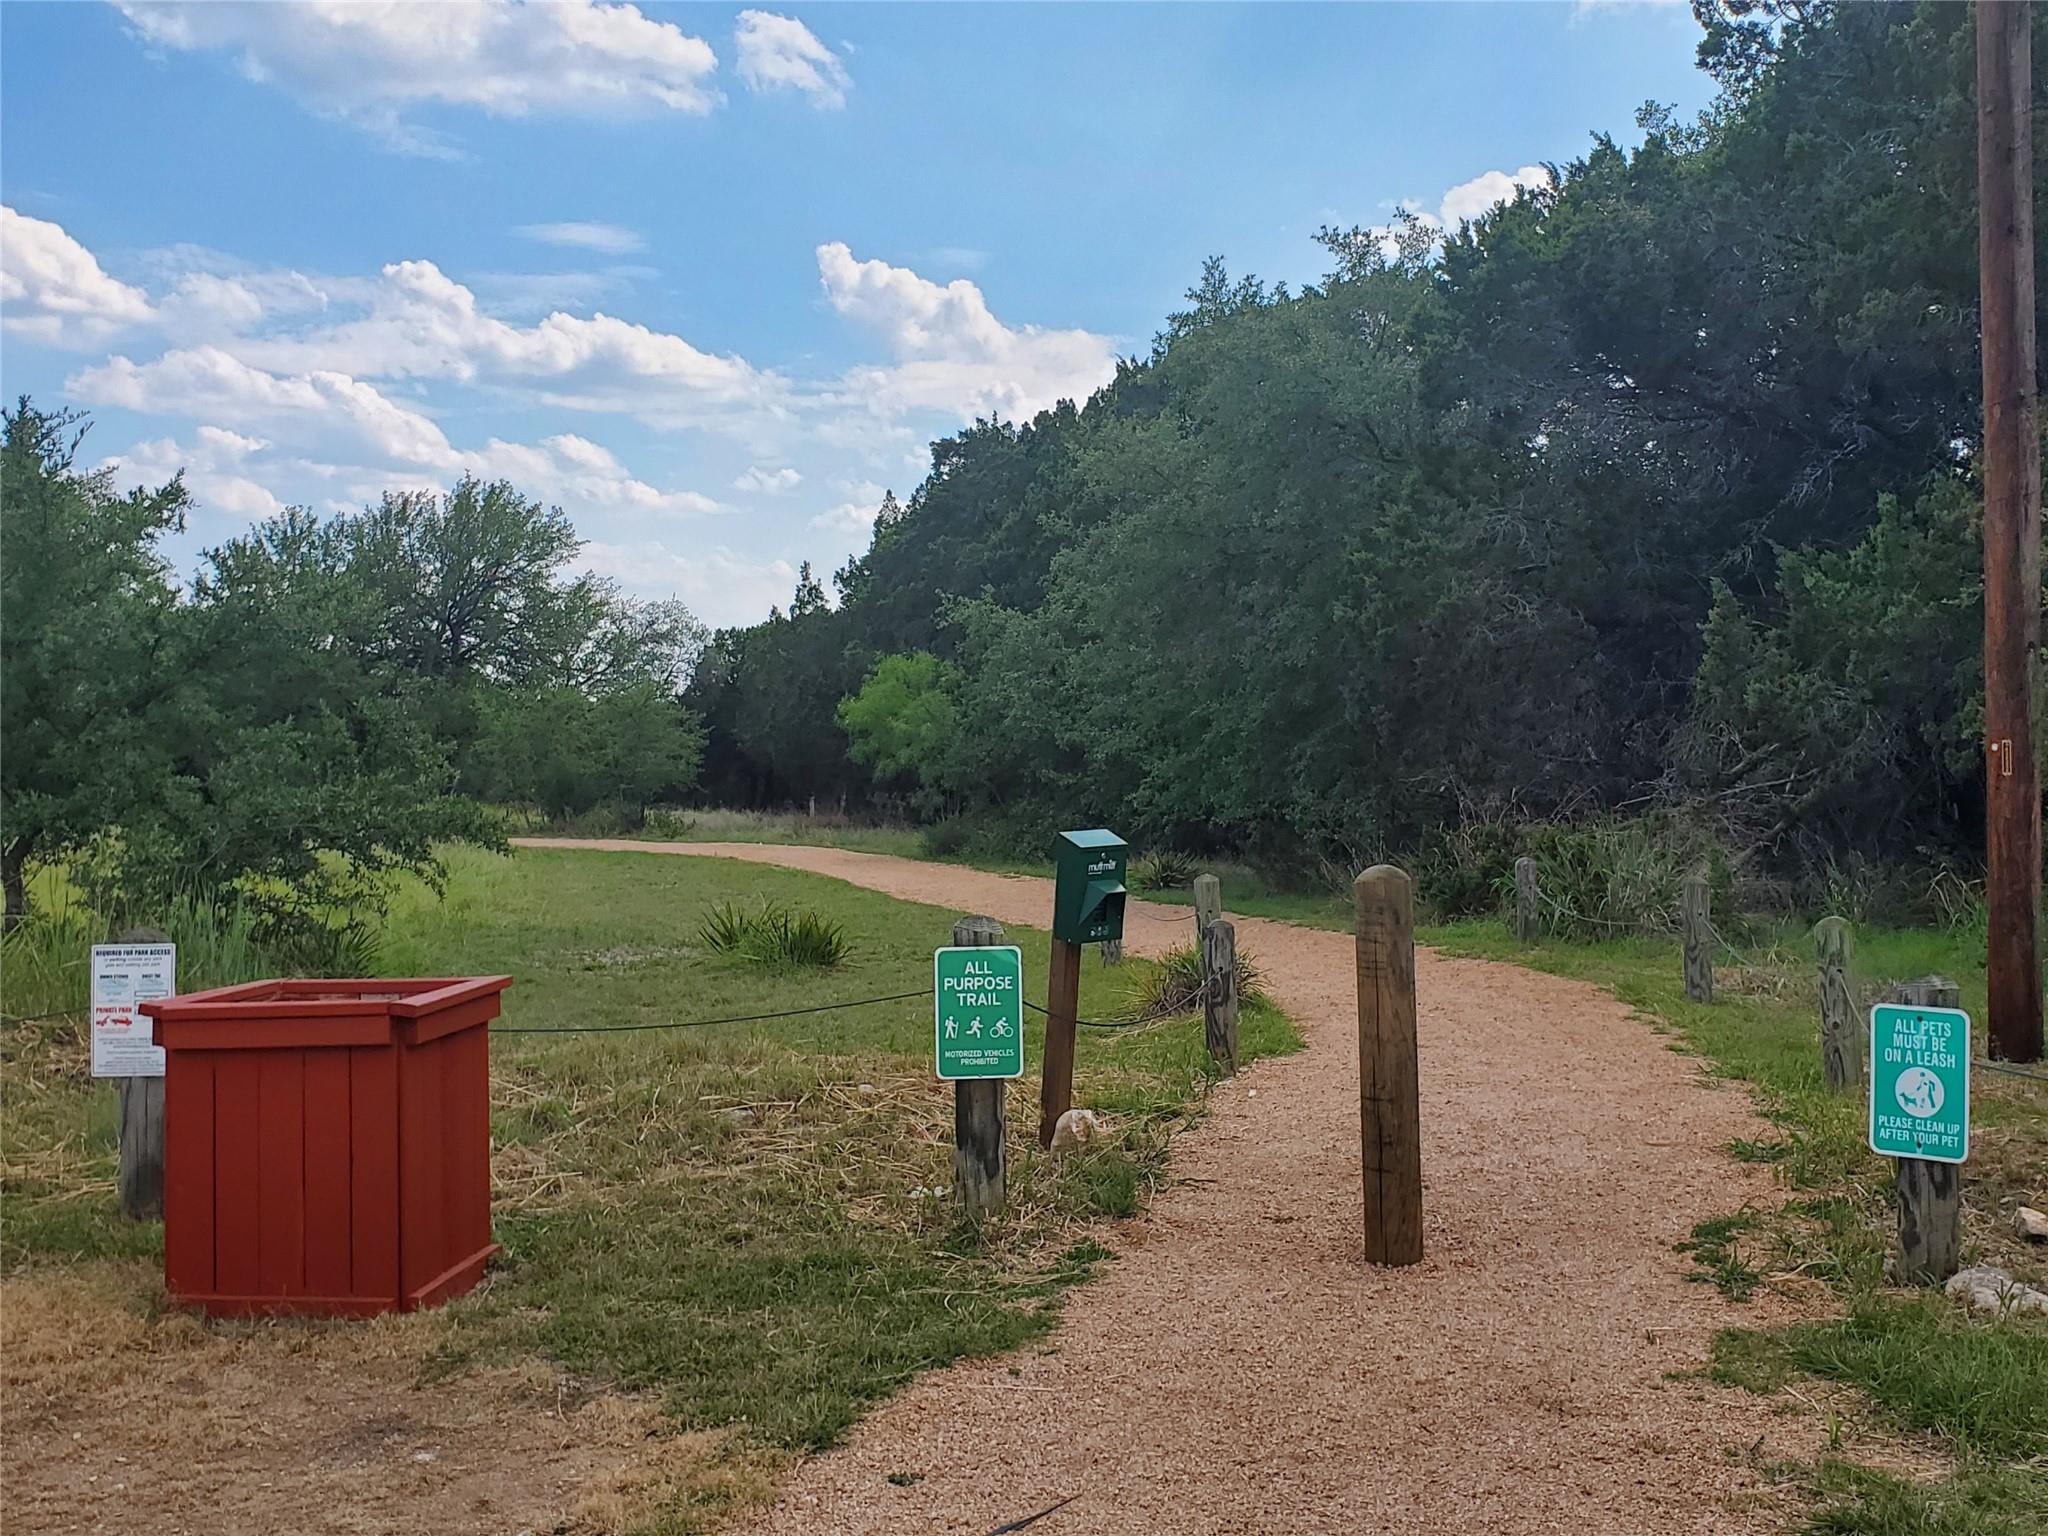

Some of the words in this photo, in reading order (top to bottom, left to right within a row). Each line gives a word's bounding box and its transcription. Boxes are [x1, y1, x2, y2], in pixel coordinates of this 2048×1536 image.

[149, 948, 171, 956] ACCESS
[965, 961, 992, 974] ALL
[944, 976, 1013, 991] PURPOSE
[956, 993, 1001, 1006] TRAIL
[1894, 1018, 1917, 1034] ALL
[1920, 1020, 1951, 1037] PETS
[1893, 1034, 1927, 1050] MUST
[1931, 1037, 1946, 1052] BE
[944, 1050, 982, 1059] MOTORIZED
[984, 1048, 1014, 1057] VEHICLES
[1885, 1048, 1901, 1063] ON
[1905, 1049, 1913, 1064] A
[1917, 1050, 1955, 1068] LEASH
[960, 1057, 999, 1066] PROHIBITED
[1878, 1115, 1912, 1129] PLEASE
[1915, 1119, 1945, 1134] CLEAN
[1947, 1123, 1960, 1134] UP
[1879, 1128, 1910, 1141] AFTER
[1912, 1131, 1938, 1146] YOUR
[1941, 1134, 1958, 1148] PET
